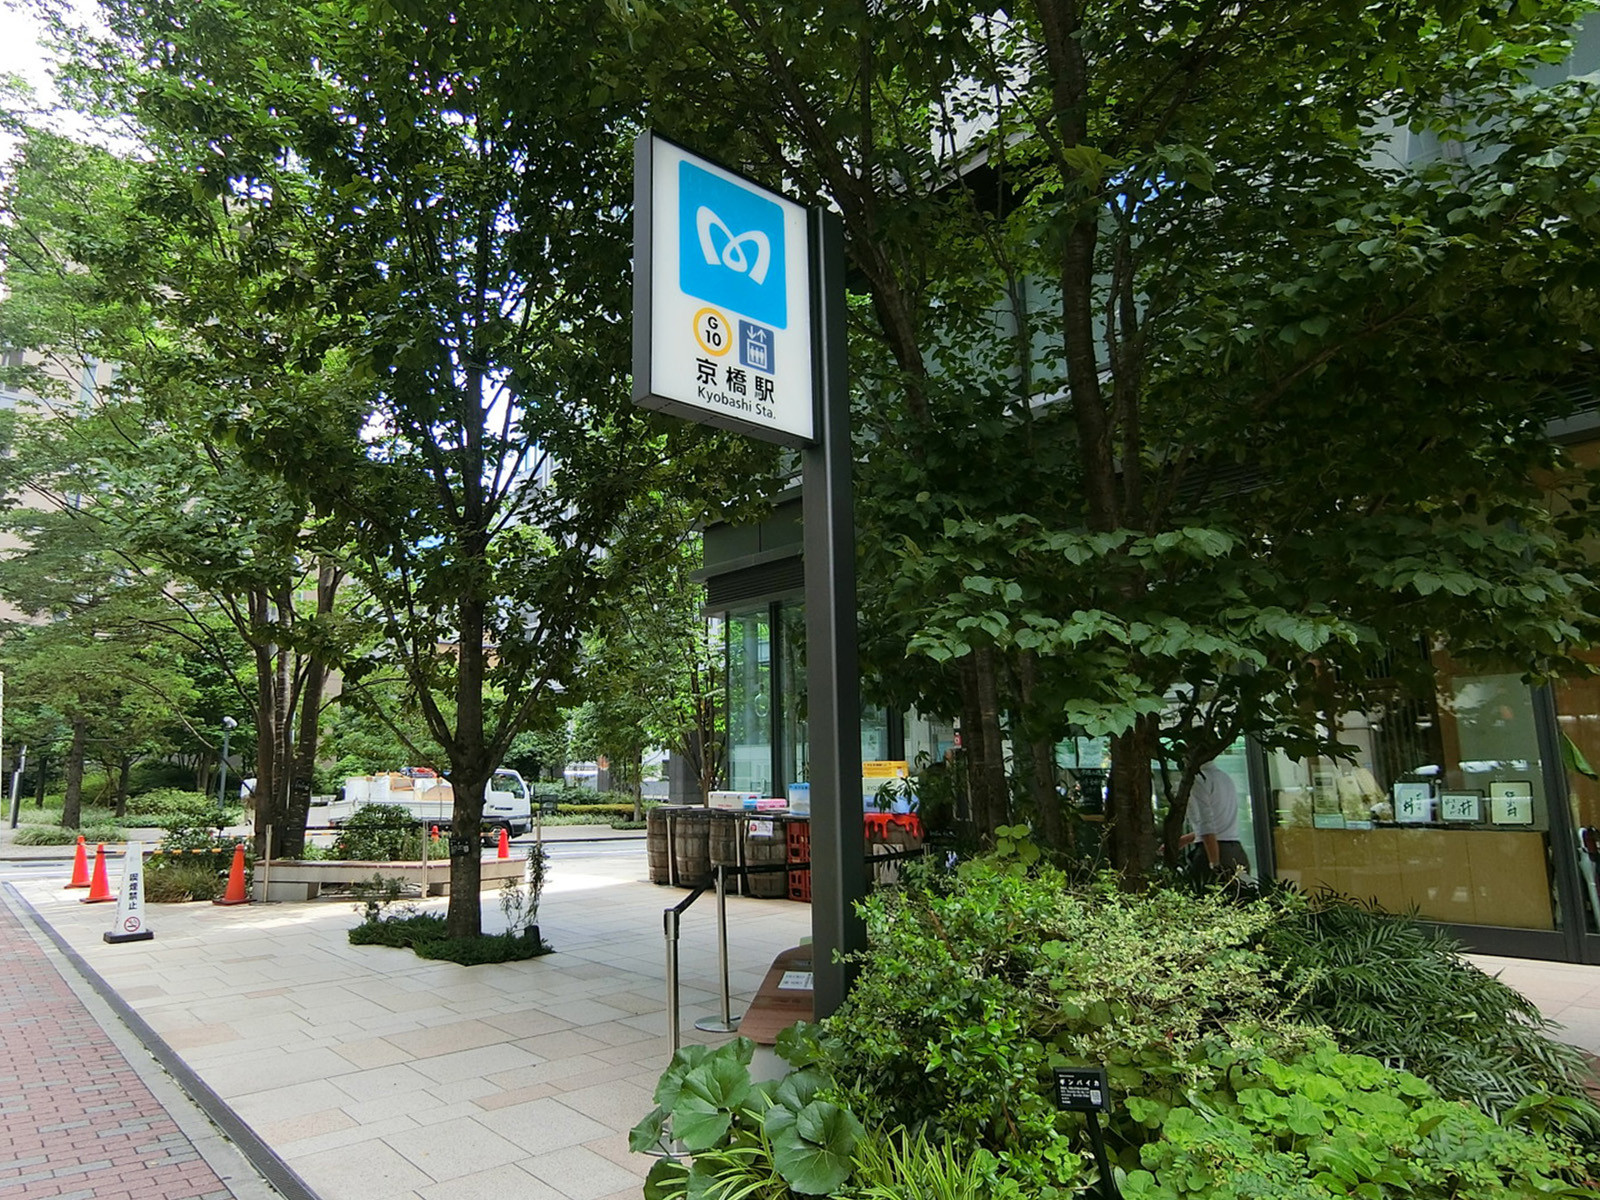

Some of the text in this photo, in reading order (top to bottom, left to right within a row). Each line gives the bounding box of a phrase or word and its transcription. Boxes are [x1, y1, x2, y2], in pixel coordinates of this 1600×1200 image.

[706, 330, 721, 347] 10
[708, 317, 719, 330] G
[696, 357, 775, 404] 京橋駅
[697, 386, 777, 420] Kyobashi Sta.
[129, 873, 138, 910] 喫煙禁止
